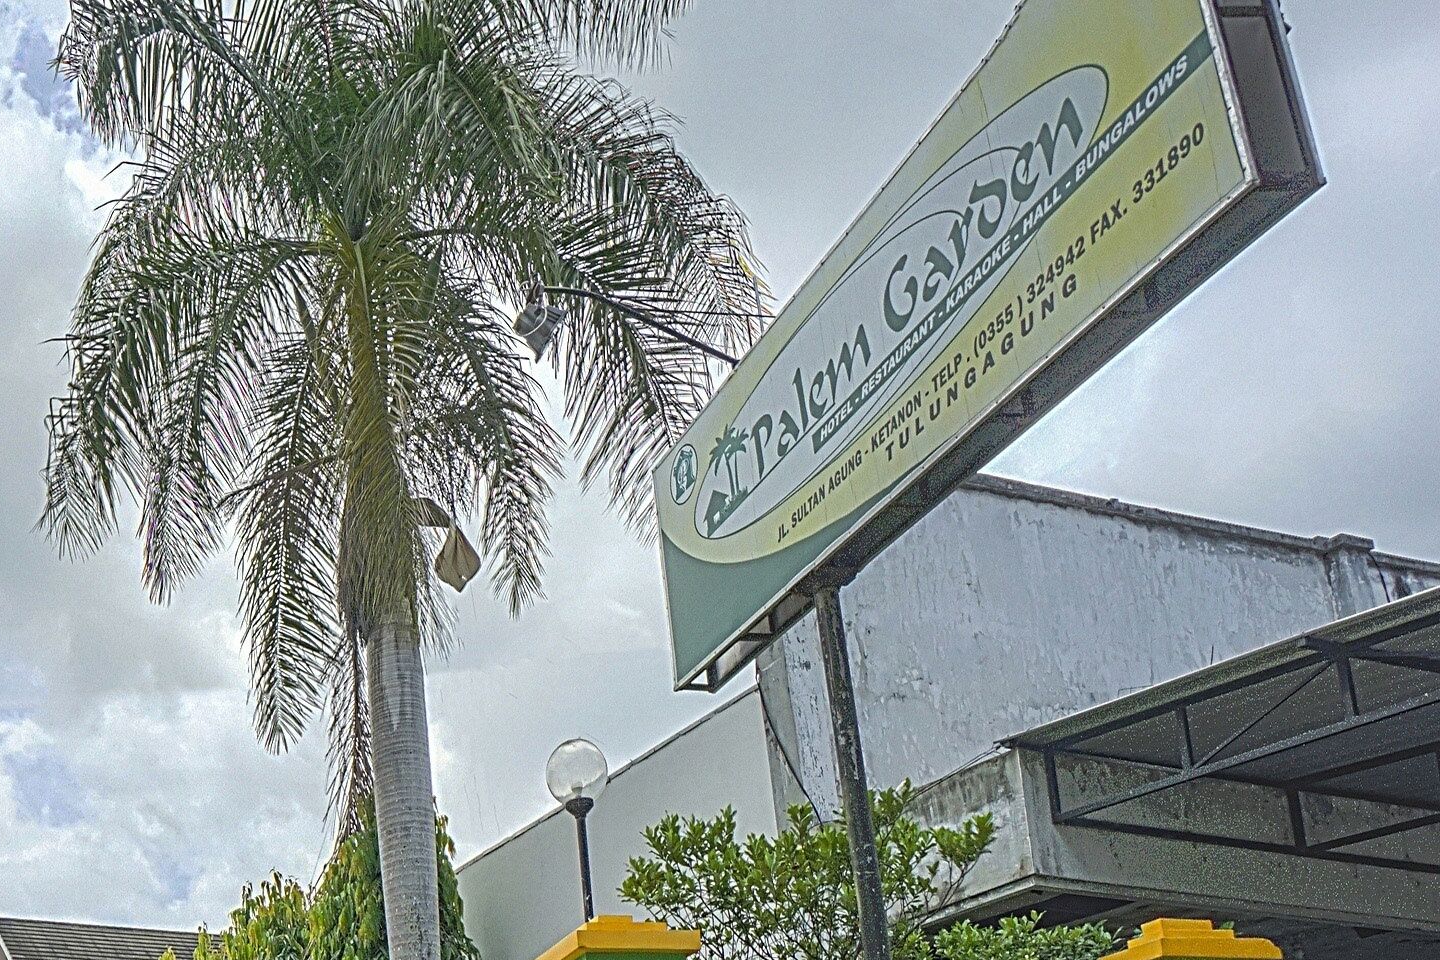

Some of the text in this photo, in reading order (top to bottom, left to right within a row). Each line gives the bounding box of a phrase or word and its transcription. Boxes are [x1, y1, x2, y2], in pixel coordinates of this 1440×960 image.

[749, 97, 1084, 479] Palem Garden
[777, 523, 790, 543] JL.
[791, 484, 826, 528] SULTAN
[828, 450, 863, 494] AGUNG
[871, 391, 922, 452] KETANON
[1026, 235, 1086, 303] 324942
[1090, 199, 1128, 245] FAX.
[1132, 122, 1205, 204] 331890
[820, 400, 854, 442] HOTEL
[861, 318, 935, 401] RESTAURANT
[945, 238, 1011, 313] KARAOKE
[1022, 189, 1062, 235] HALL
[1075, 55, 1188, 182] BUNGALOWS
